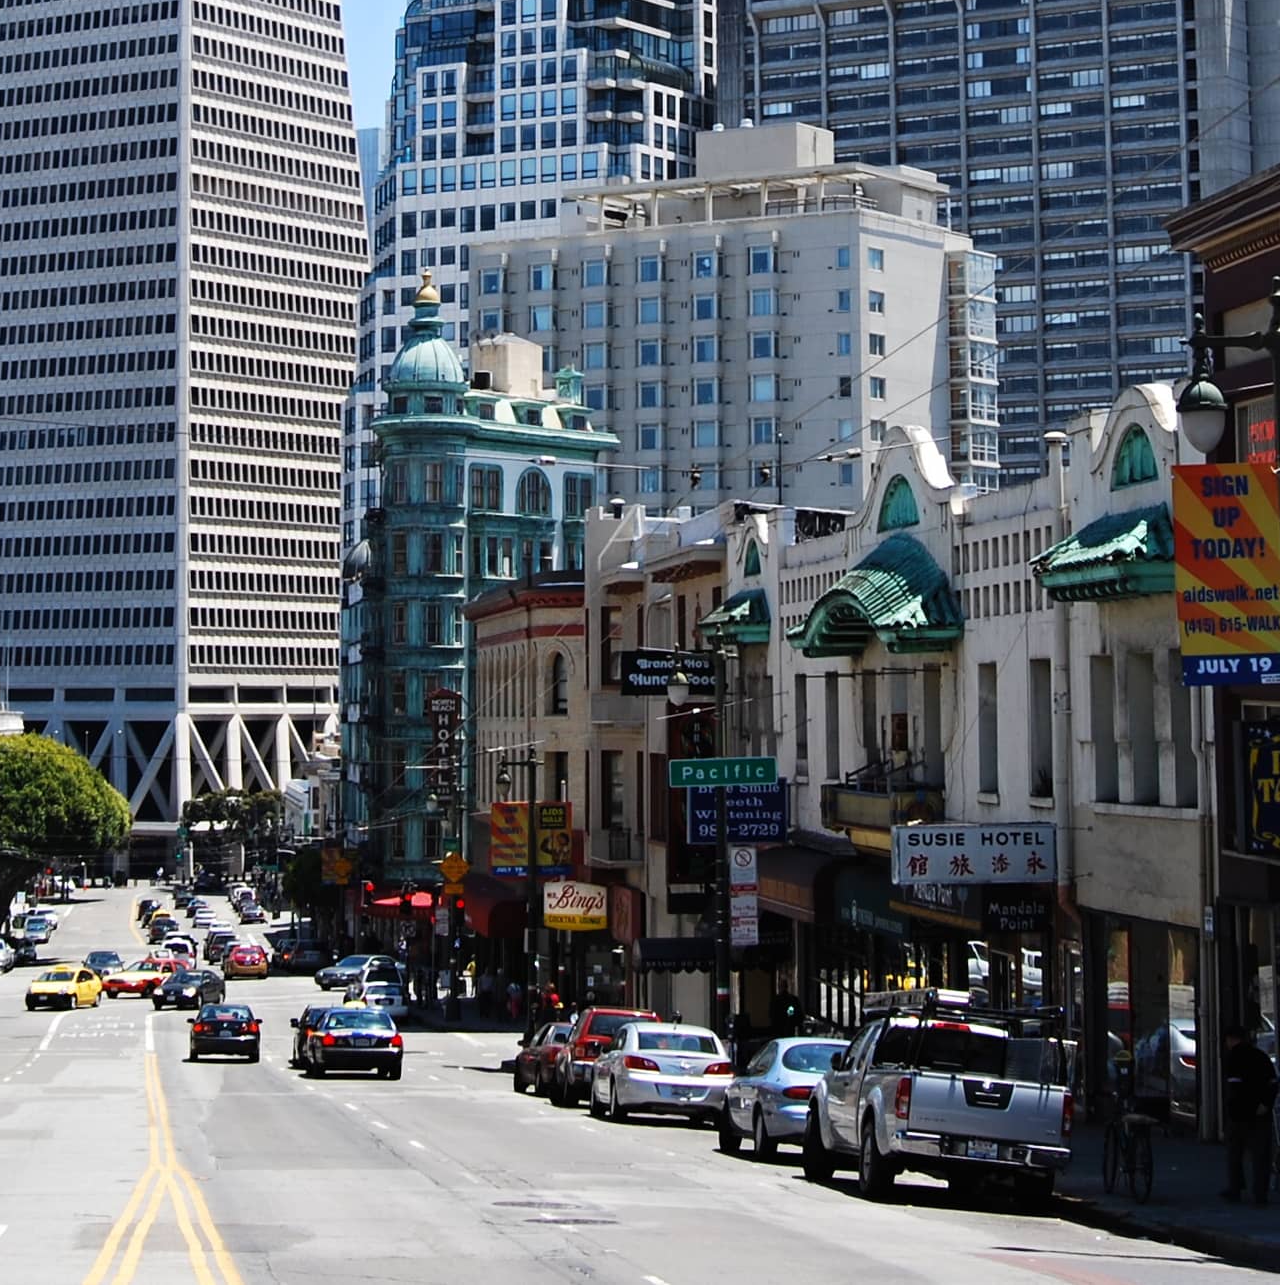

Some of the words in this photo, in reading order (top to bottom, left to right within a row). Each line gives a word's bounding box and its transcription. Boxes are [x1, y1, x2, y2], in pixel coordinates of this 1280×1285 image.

[1201, 475, 1249, 498] SIGN
[1213, 507, 1241, 528] UP
[1192, 537, 1266, 560] TODAY!
[1183, 585, 1280, 603] aidswalk.net
[1184, 617, 1216, 636] (415)
[1219, 616, 1280, 634] 615-WALK
[636, 658, 676, 669] Brand
[1197, 658, 1240, 674] JULY
[1250, 657, 1272, 672] 19
[438, 713, 449, 786] HOTEL
[682, 765, 765, 781] Pacific
[739, 784, 780, 794] Smile
[907, 832, 965, 846] SUSIE
[981, 832, 1045, 846] HOTEL
[548, 884, 604, 915] Bing's
[987, 898, 1045, 915] Mandala
[1000, 916, 1033, 931] Point
